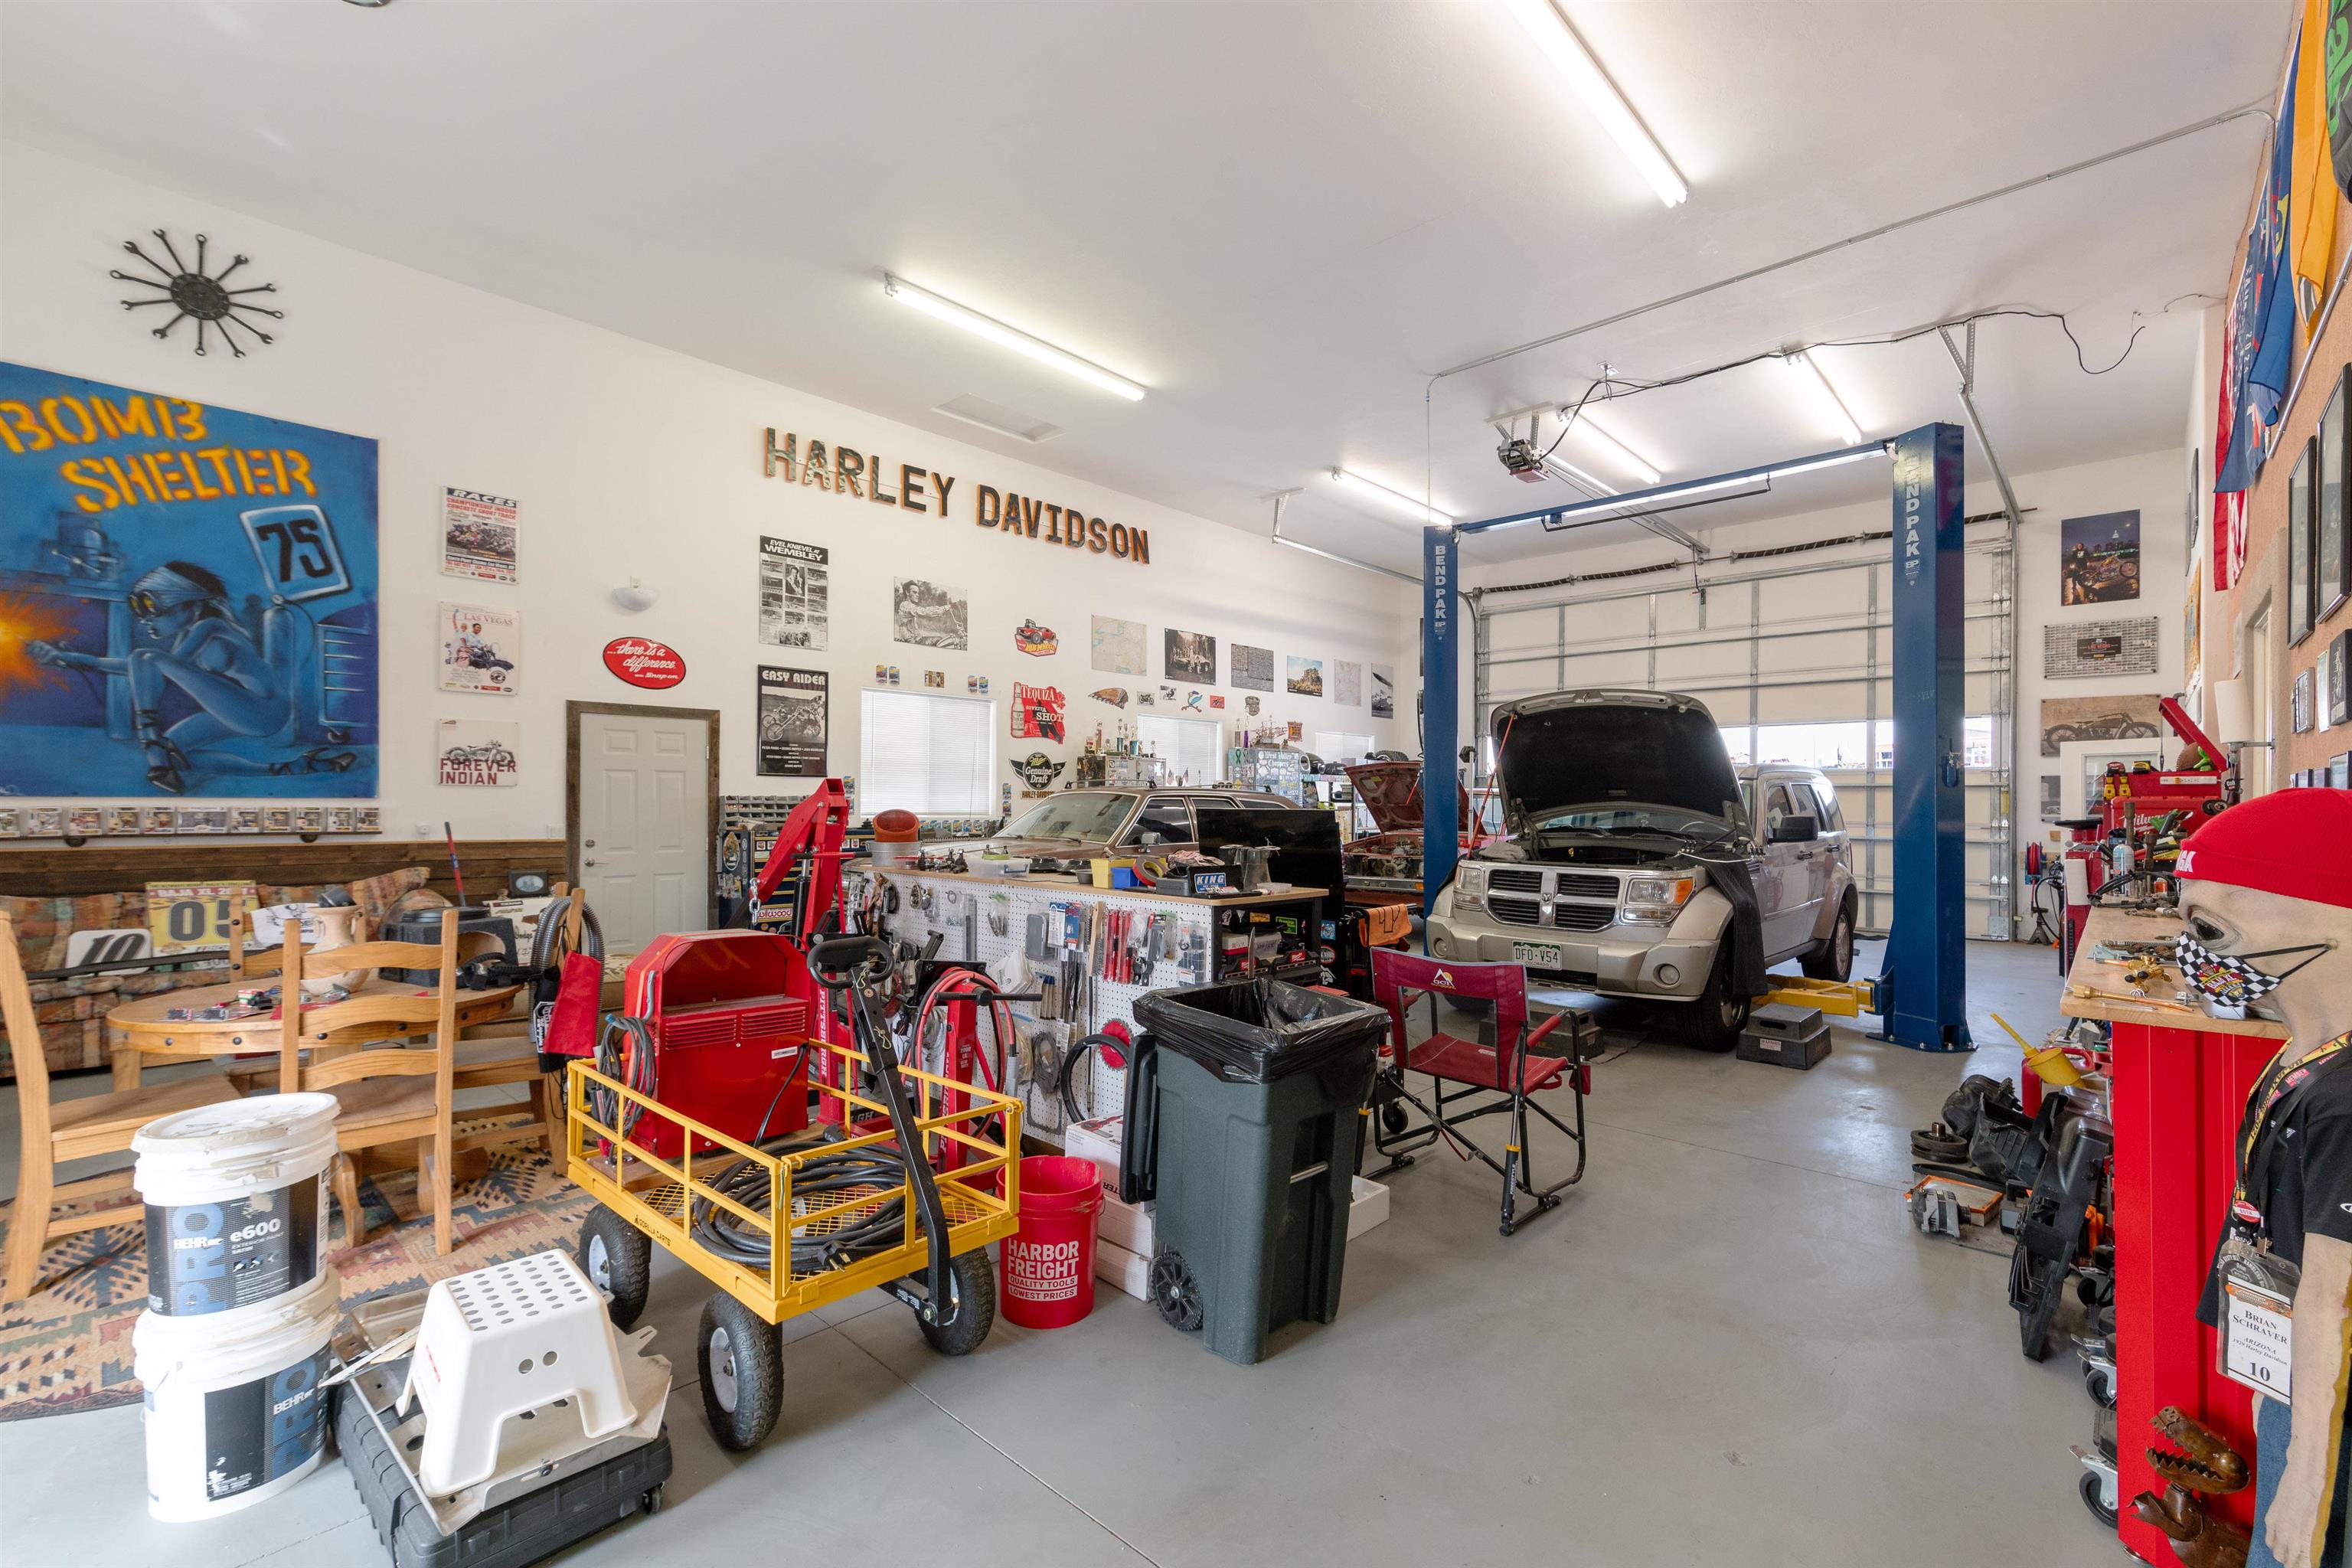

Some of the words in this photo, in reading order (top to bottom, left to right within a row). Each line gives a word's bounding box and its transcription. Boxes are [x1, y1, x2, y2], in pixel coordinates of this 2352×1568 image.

[0, 395, 209, 454] BOMB
[60, 449, 318, 514] SHELTER
[452, 490, 516, 508] RACES
[765, 426, 956, 517] HARLEY
[976, 483, 1151, 564] DAVIDSON
[256, 518, 334, 583] 75
[764, 544, 823, 561] WEMBLEY
[769, 539, 787, 548] EVEL
[787, 542, 813, 553] KNIEVEL
[465, 612, 482, 621] LAS
[484, 615, 514, 625] VEGAS
[762, 670, 790, 681] EASY
[793, 673, 825, 685] RIDER
[1021, 685, 1054, 701] TEQUIZA
[1036, 712, 1063, 722] SHOT
[440, 757, 517, 773] FOREVER
[1025, 766, 1052, 775] Genuine
[440, 771, 497, 785] INDIAN
[1030, 775, 1048, 783] Draft
[1197, 875, 1224, 884] KING
[158, 888, 194, 897] BAJA
[2207, 977, 2227, 989] BAJA
[2285, 1069, 2307, 1083] MEMBER
[230, 1218, 282, 1243] e600
[639, 1219, 656, 1237] GORILLA
[655, 1231, 671, 1246] CARTS
[1008, 1237, 1080, 1261] HARBOR
[1008, 1256, 1080, 1279] FREIGHT
[1010, 1276, 1044, 1289] QUALITY
[1047, 1277, 1075, 1289] TOOLS
[1010, 1286, 1041, 1299] LOWEST
[1043, 1289, 1075, 1300] PRICES
[2246, 1310, 2277, 1330] BRIAN
[2233, 1315, 2288, 1344] SCHRAVER
[2244, 1337, 2276, 1354] ARIZONA
[2246, 1344, 2262, 1355] Harley
[2263, 1352, 2288, 1366] Davidson
[2250, 1362, 2271, 1382] 10
